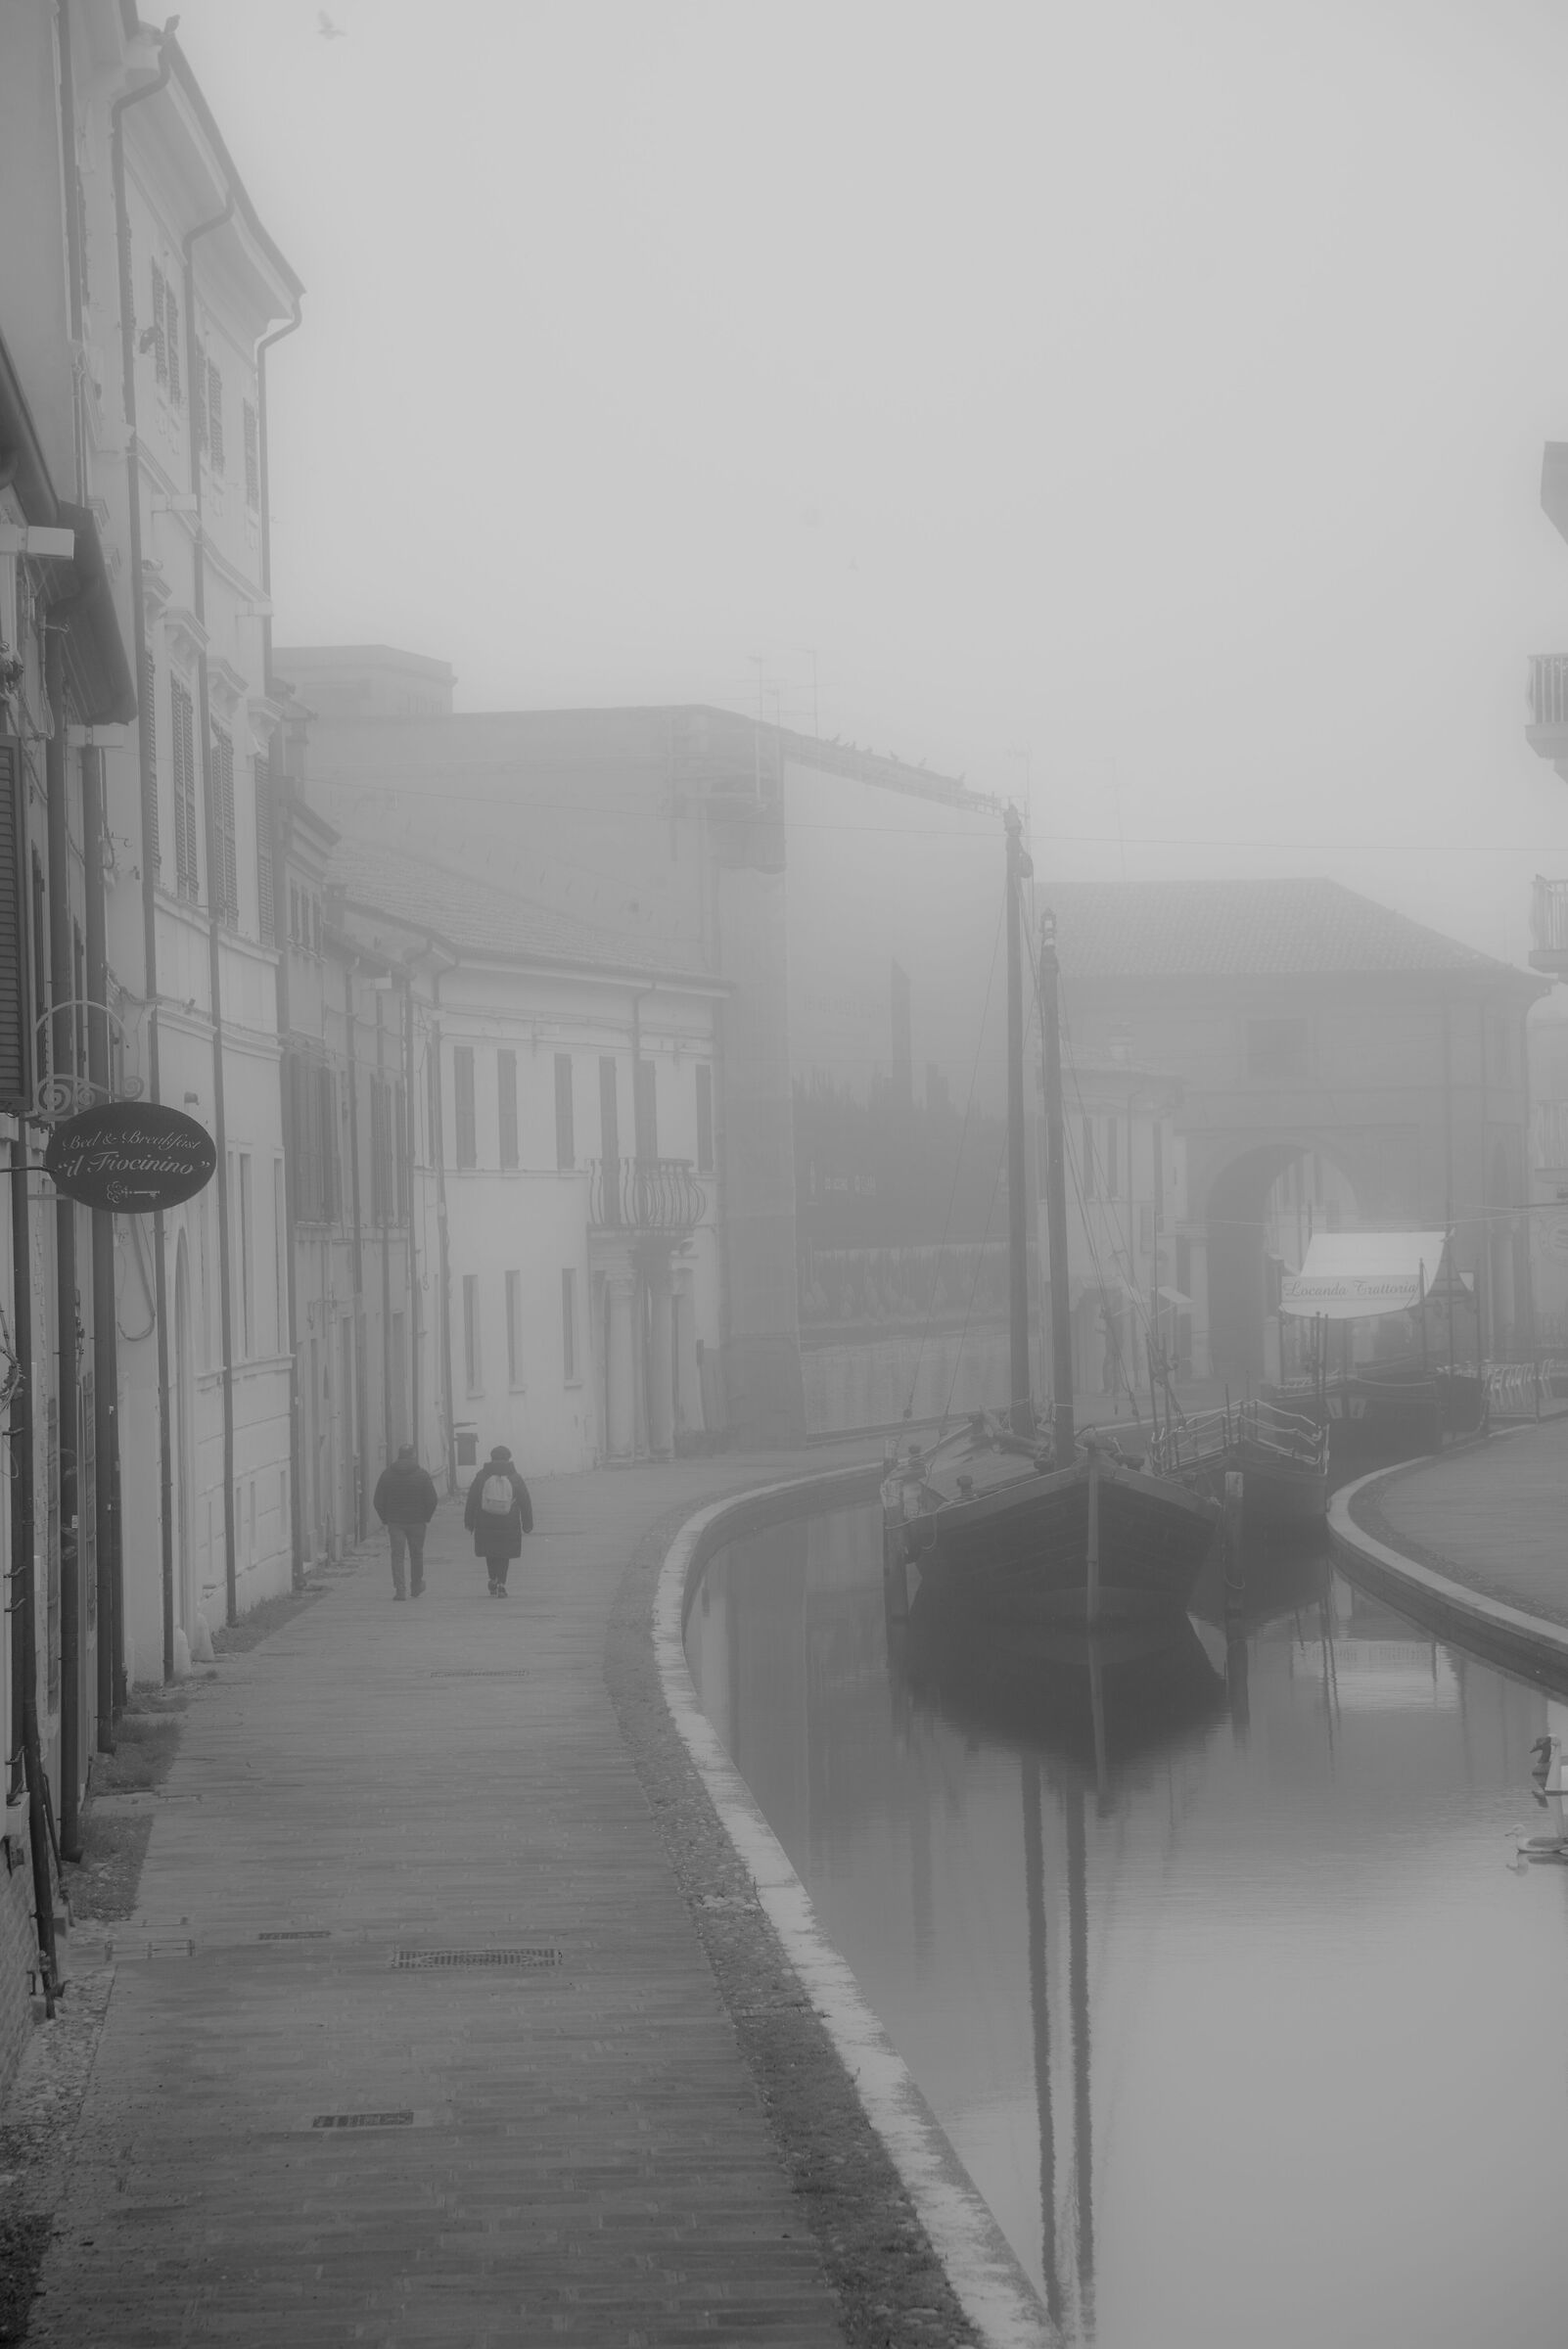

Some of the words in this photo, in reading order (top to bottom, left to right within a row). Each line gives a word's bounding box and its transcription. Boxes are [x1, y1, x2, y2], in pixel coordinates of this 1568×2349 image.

[63, 1131, 101, 1150] Bed
[103, 1132, 117, 1145] &
[122, 1130, 202, 1151] Breakfast
[1283, 1279, 1348, 1297] Locanda
[1354, 1278, 1418, 1296] Trattoria
